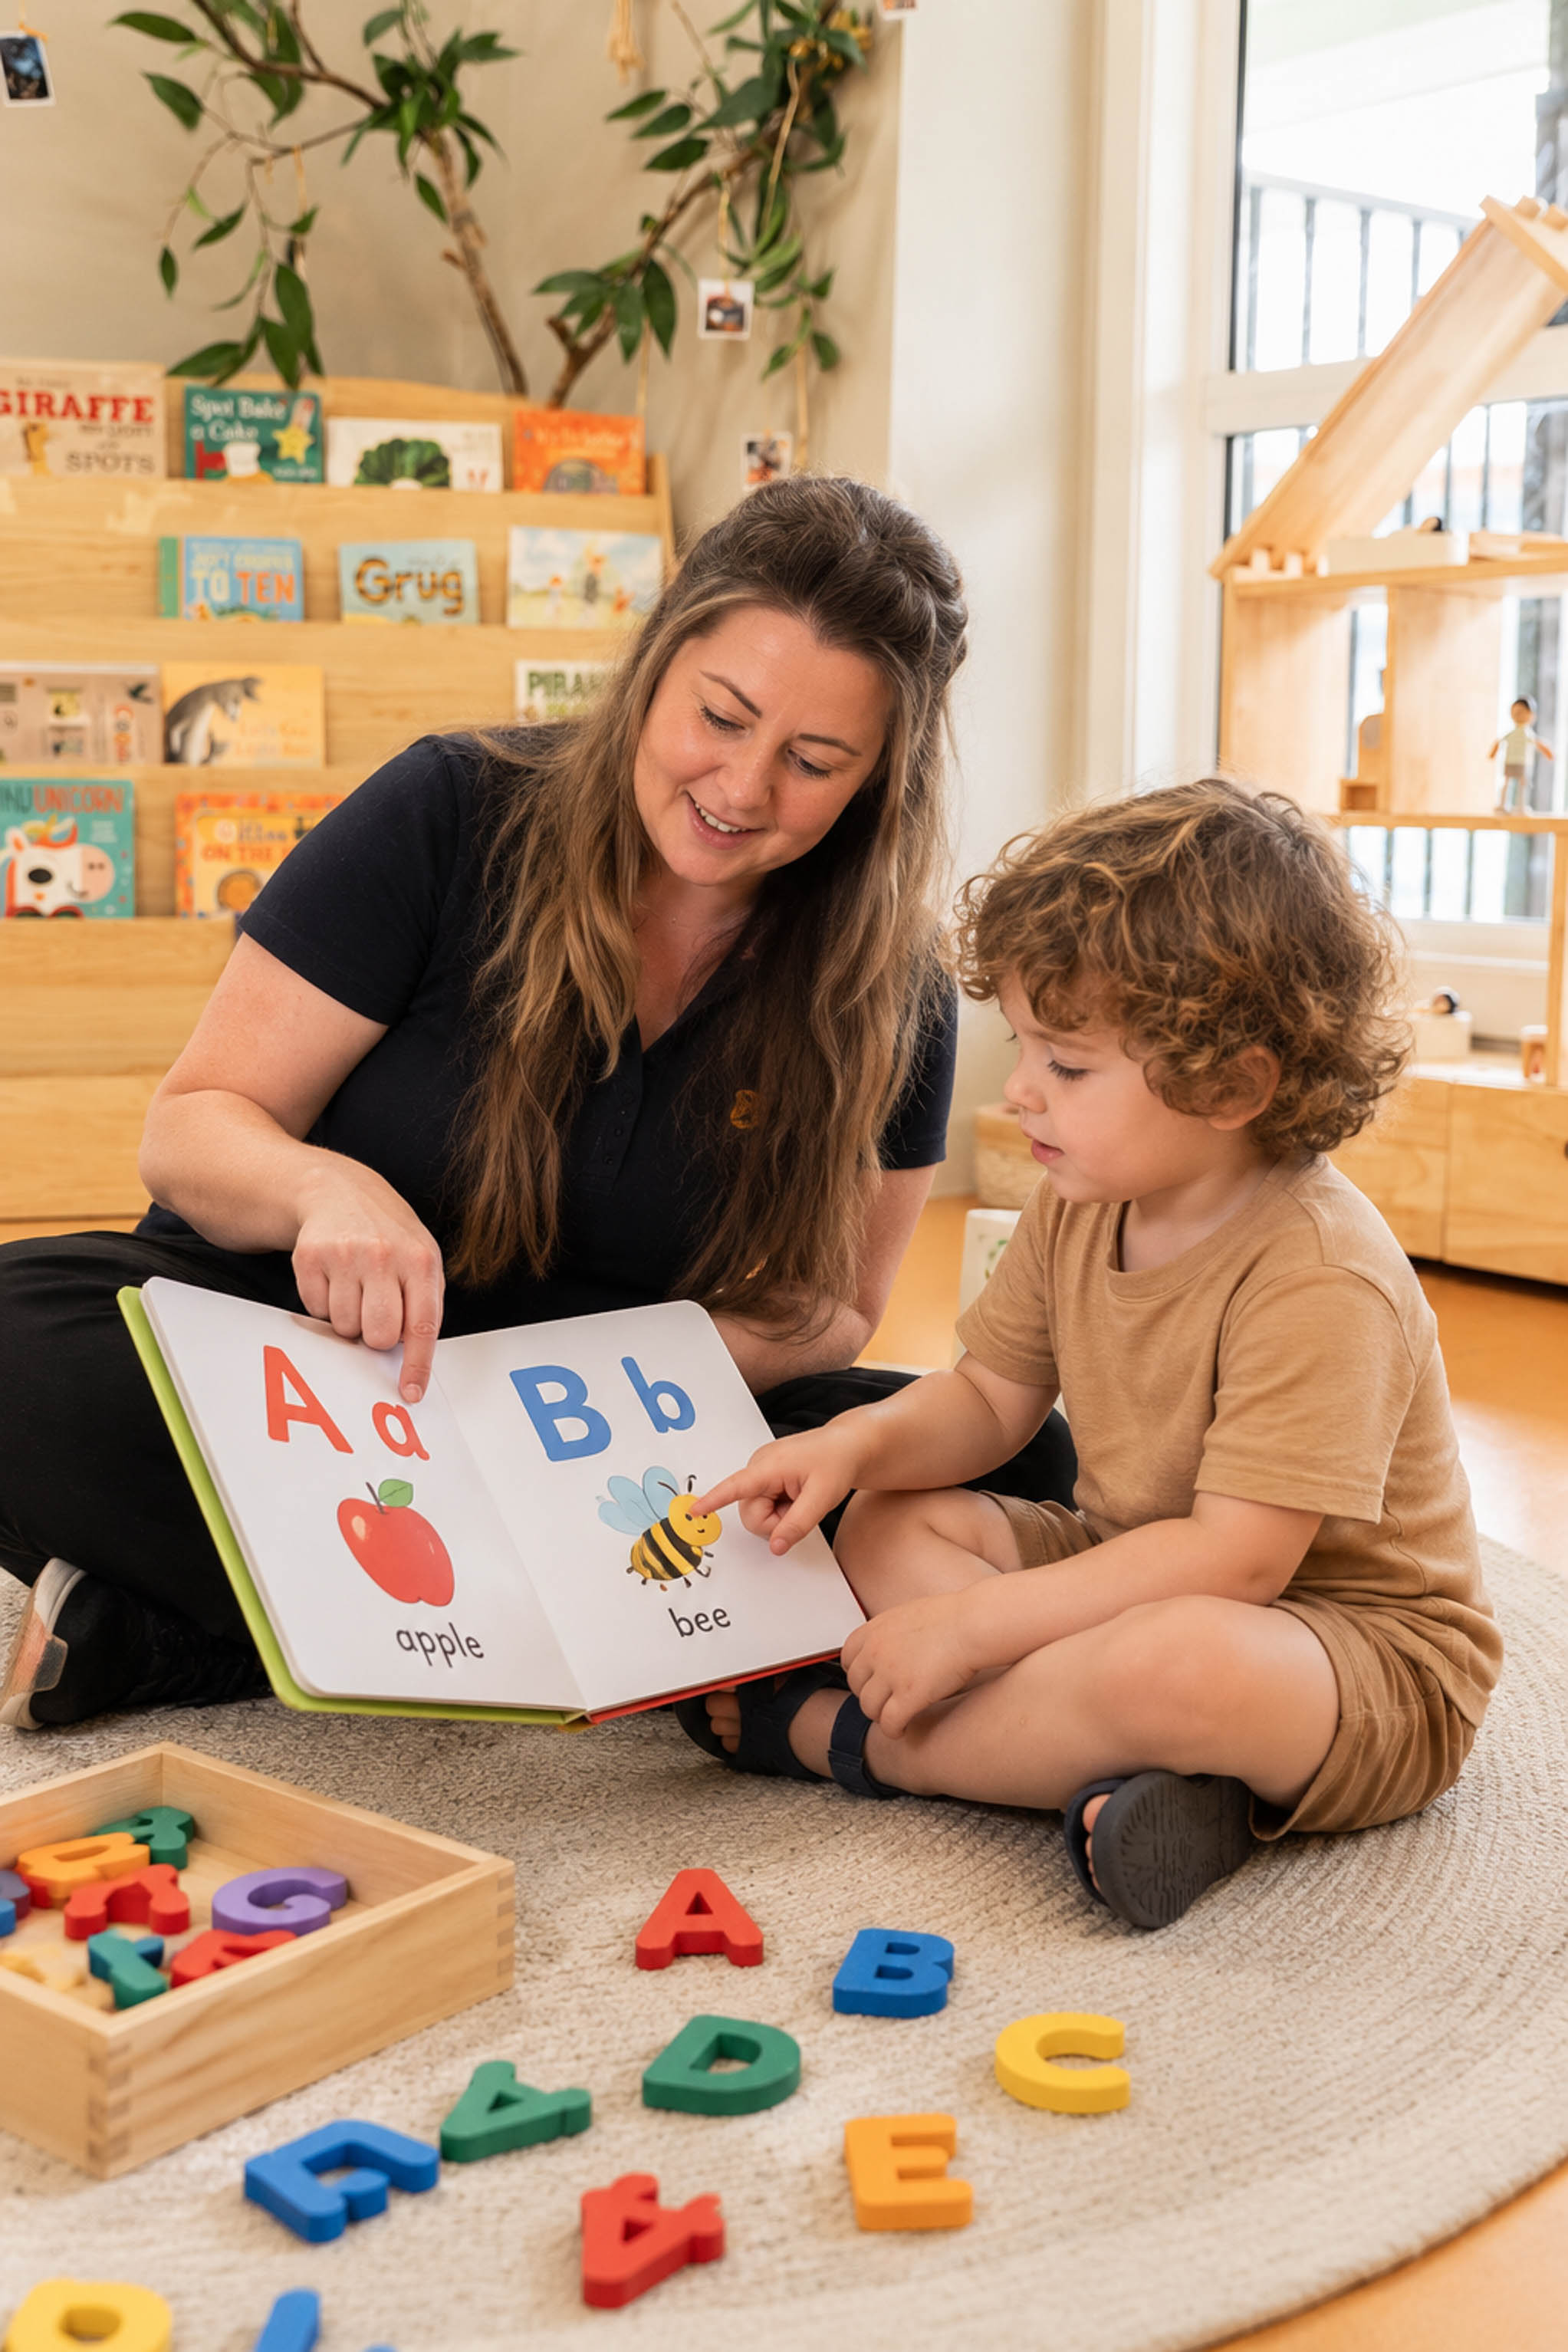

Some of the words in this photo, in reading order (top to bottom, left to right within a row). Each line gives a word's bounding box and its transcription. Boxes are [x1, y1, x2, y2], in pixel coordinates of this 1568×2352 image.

[0, 389, 155, 424] GIRAFFE
[190, 394, 234, 421] Spot
[208, 421, 259, 442] Cake
[190, 570, 230, 604] TO
[235, 571, 296, 605] TEN
[355, 557, 465, 617] Grug
[33, 785, 123, 814] UNICORN
[263, 1344, 354, 1454] A
[372, 1401, 431, 1461] a
[509, 1365, 612, 1462] B
[621, 1356, 696, 1434] b
[396, 1622, 485, 1668] apple
[668, 1607, 731, 1638] bee
[635, 1868, 764, 1971] A
[832, 1927, 955, 2019] B
[641, 2014, 802, 2117] D
[994, 2011, 1132, 2115] C
[843, 2113, 974, 2232] E
